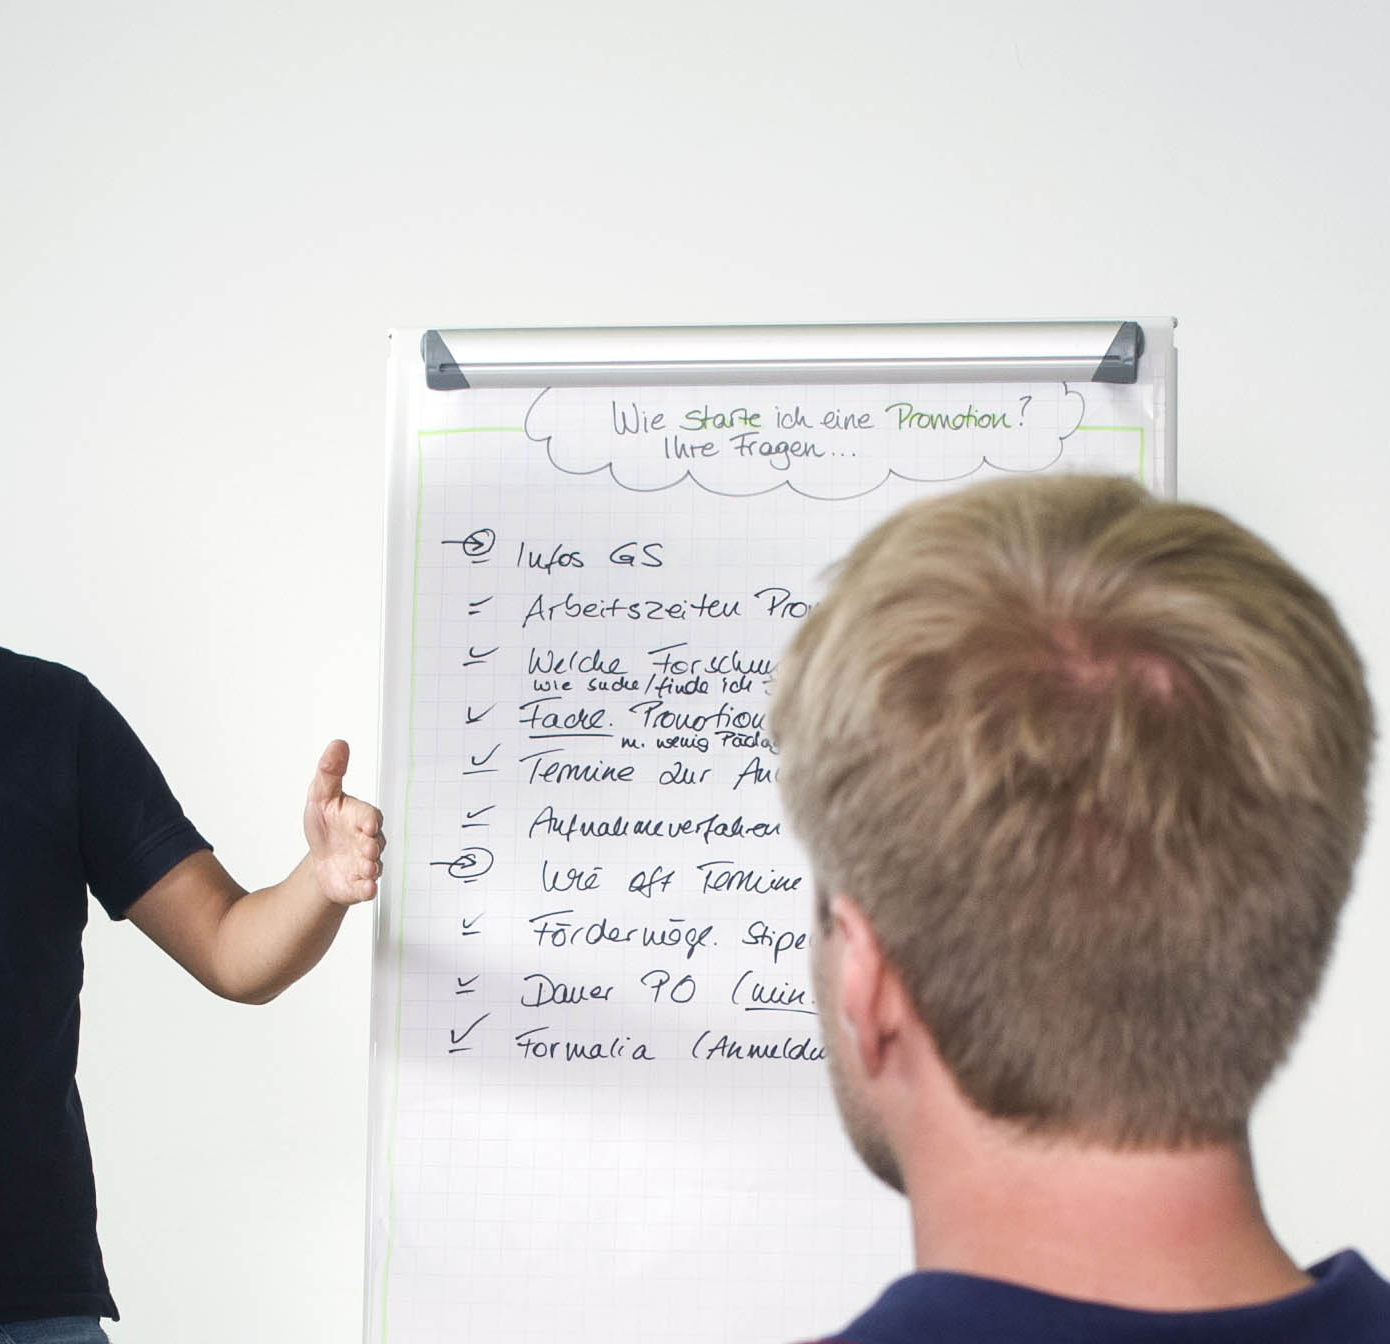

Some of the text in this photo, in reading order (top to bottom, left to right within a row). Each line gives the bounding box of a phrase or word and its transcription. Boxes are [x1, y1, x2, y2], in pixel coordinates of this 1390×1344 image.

[612, 400, 665, 435] Wie
[775, 405, 813, 429] ich
[820, 409, 874, 430] eine
[665, 435, 719, 458] Ihre
[517, 542, 663, 574] Infos GS
[522, 587, 813, 628] Arbeitszeiten Pro
[528, 648, 627, 675] Welche
[534, 679, 572, 691] wie
[722, 675, 752, 693] ich
[657, 733, 709, 753] wenig
[519, 748, 634, 785] Termine
[660, 762, 712, 785] zur
[543, 860, 803, 898] Wie oft Termine
[521, 974, 614, 1007] Dauer
[640, 970, 697, 1003] PO
[515, 1027, 656, 1059] Formalia
